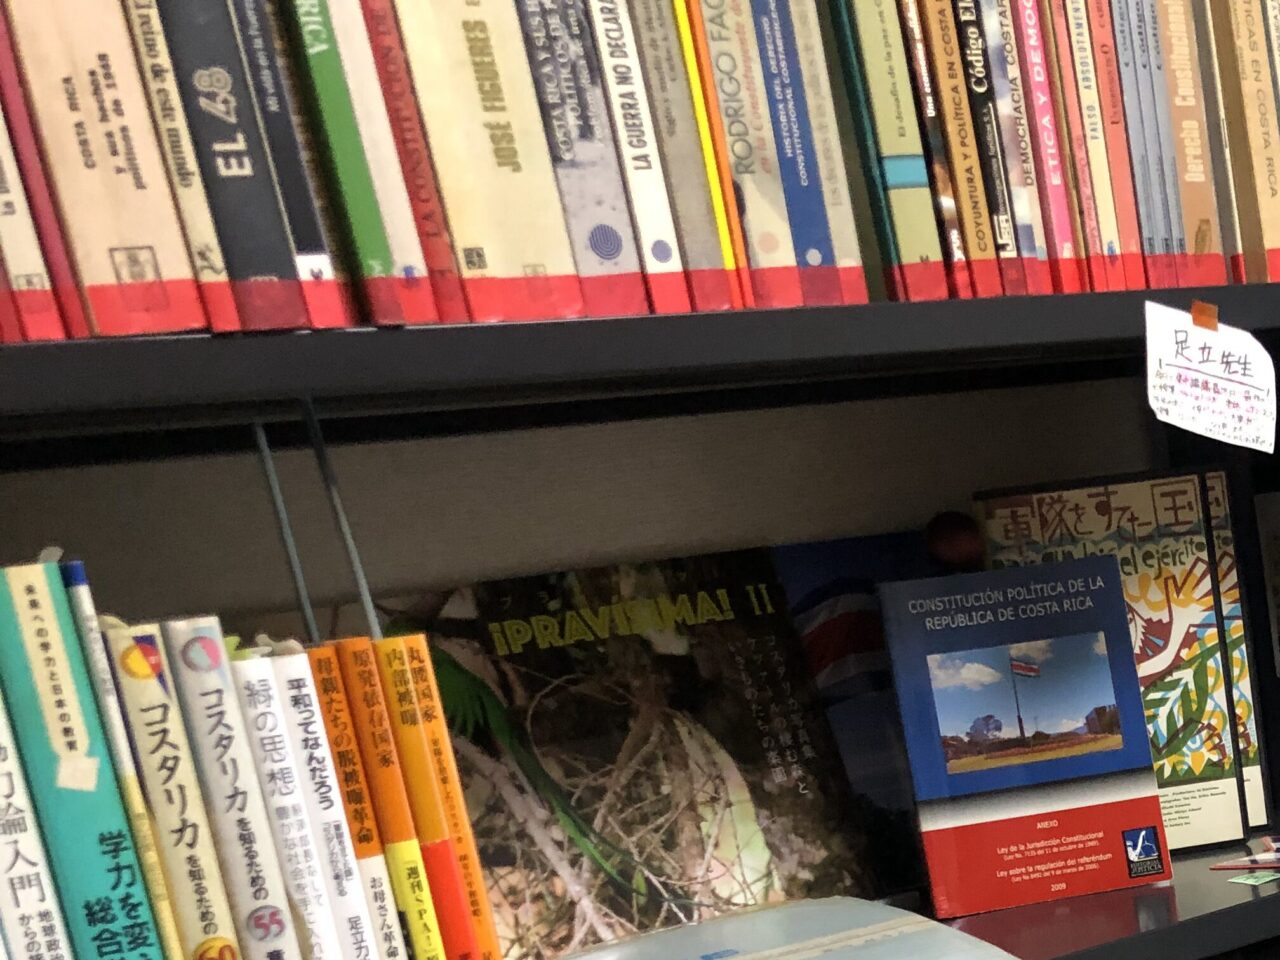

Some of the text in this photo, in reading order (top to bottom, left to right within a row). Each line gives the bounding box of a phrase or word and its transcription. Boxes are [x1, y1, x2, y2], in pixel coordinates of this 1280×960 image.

[461, 20, 508, 112] FIGUERES
[761, 16, 794, 158] HISTORIA DEL DERECHO
[965, 26, 988, 93] Código
[156, 88, 195, 188] este mundo
[191, 66, 254, 177] EL 48
[540, 63, 575, 161] COSTA RICA
[612, 64, 652, 171] LA GUERRA NO
[716, 52, 755, 175] RODRIGO
[783, 84, 809, 187] CONSTITUCIONAL
[937, 7, 987, 252] COYUNTURA POLÍTICA COSTA
[1011, 77, 1035, 186] DEMOCRACIA
[1039, 118, 1062, 185] ETICA
[1084, 104, 1101, 141] FALSO
[1181, 119, 1205, 182] Derecho
[1251, 59, 1278, 198] EN COSTA RICA
[1174, 330, 1254, 378] 足立先生
[908, 576, 1105, 614] CONSTITUCIÓN POLÍTICA DE LA
[925, 596, 1094, 631] REPÚBLICA DE COSTA RICA
[243, 679, 297, 797] 緑の思想
[286, 677, 335, 812] 平和ってなんだろう
[1036, 820, 1059, 830] ANEXO
